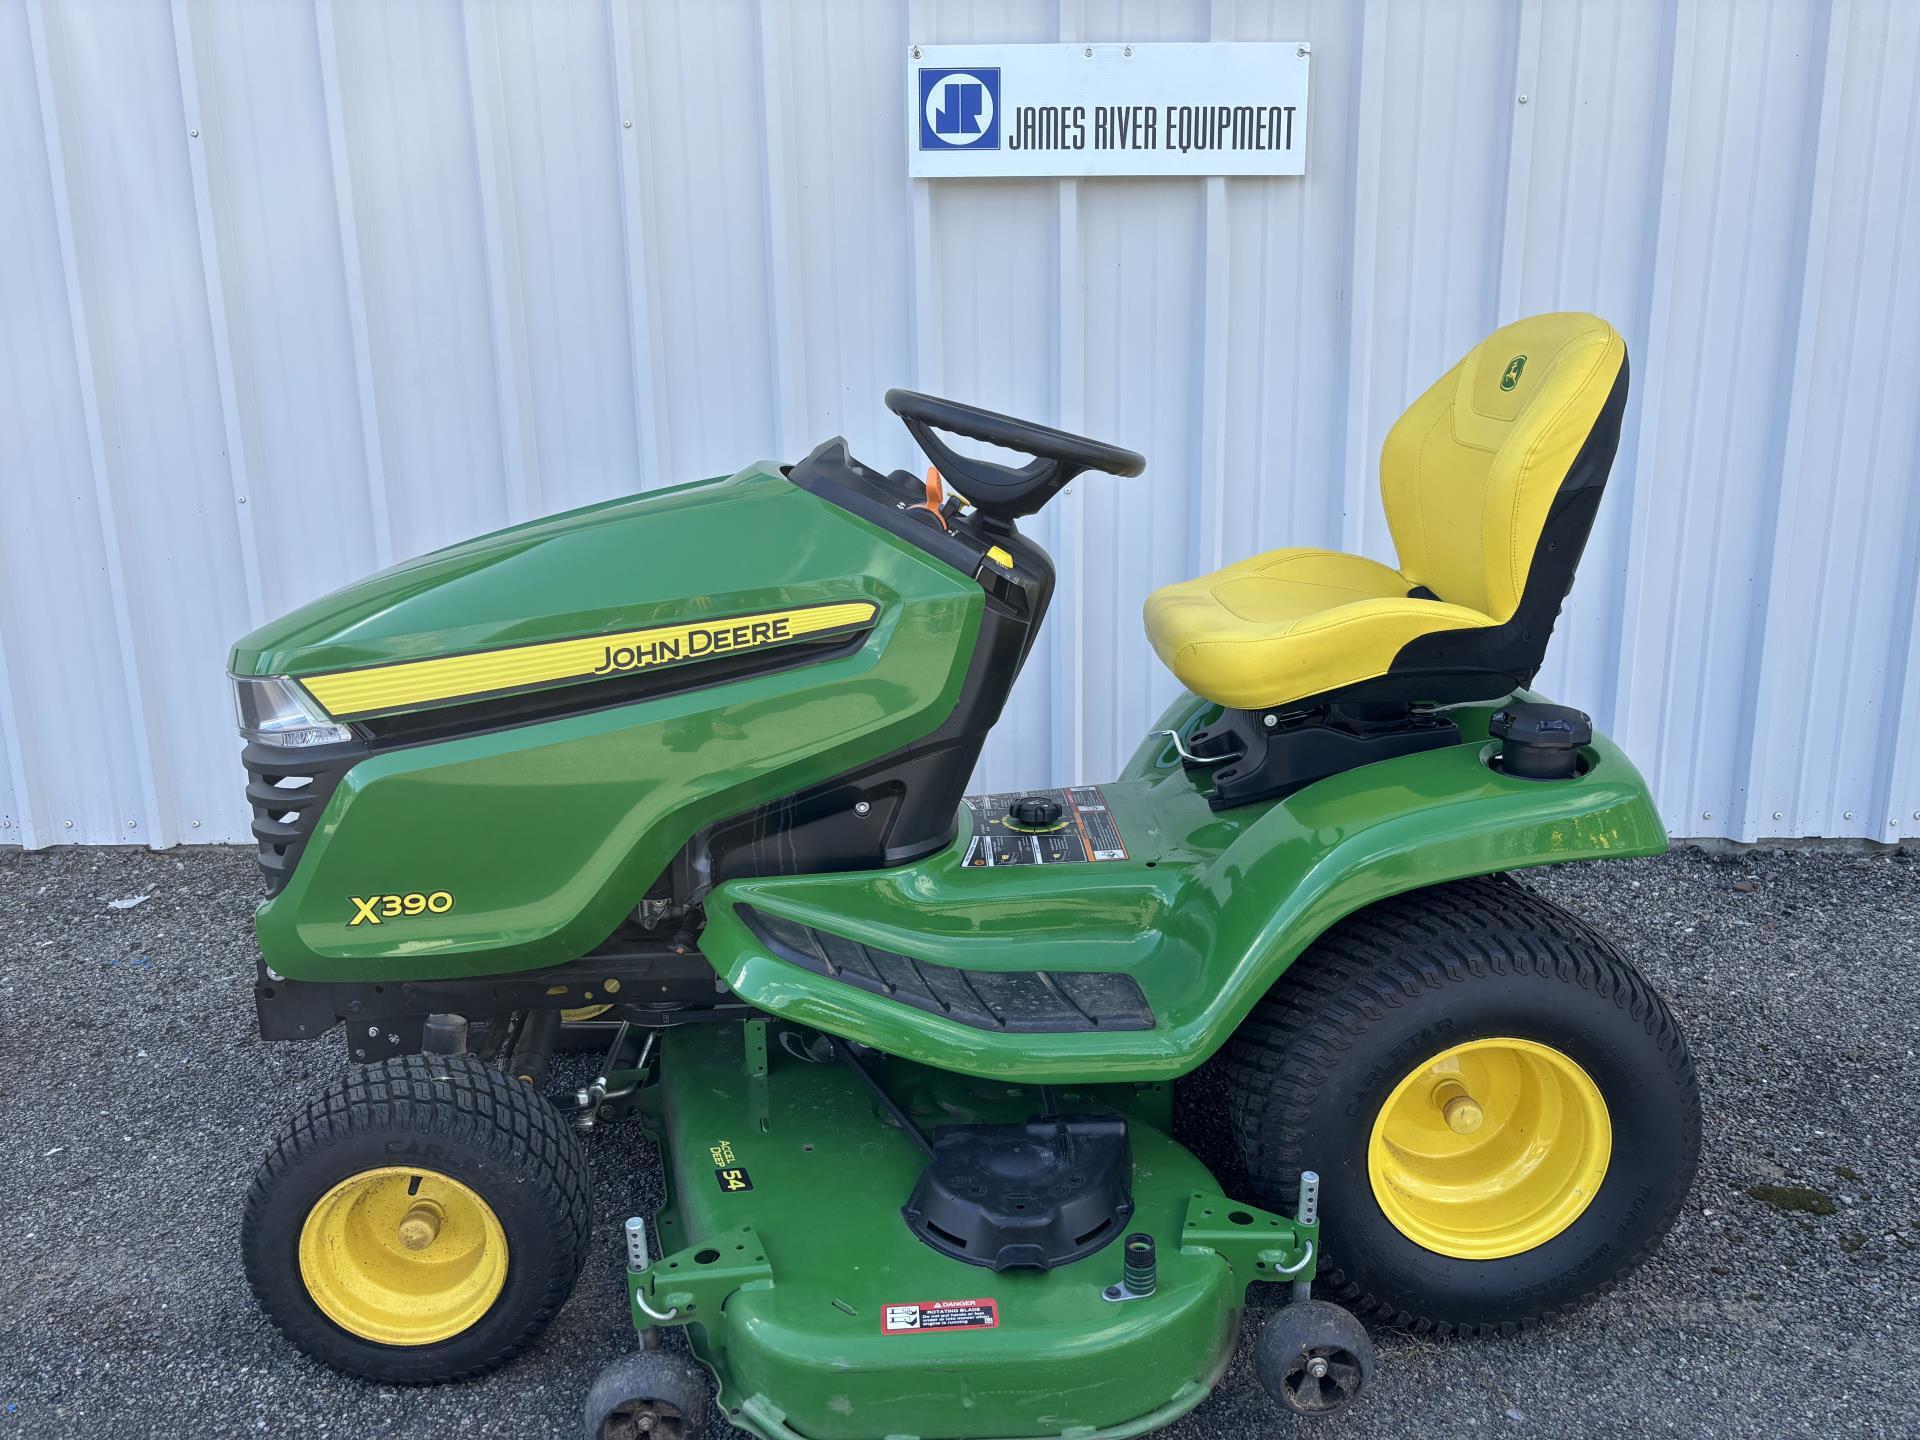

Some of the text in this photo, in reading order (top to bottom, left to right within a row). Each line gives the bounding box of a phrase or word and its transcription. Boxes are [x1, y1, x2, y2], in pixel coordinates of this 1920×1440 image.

[1008, 105, 1297, 153] JAMES RIVER EQUIPMENT
[595, 617, 790, 672] JOHN DEERE
[347, 890, 455, 926] X390
[710, 1147, 726, 1167] DEEP
[718, 1140, 736, 1164] ACCEL
[722, 1170, 746, 1190] 54
